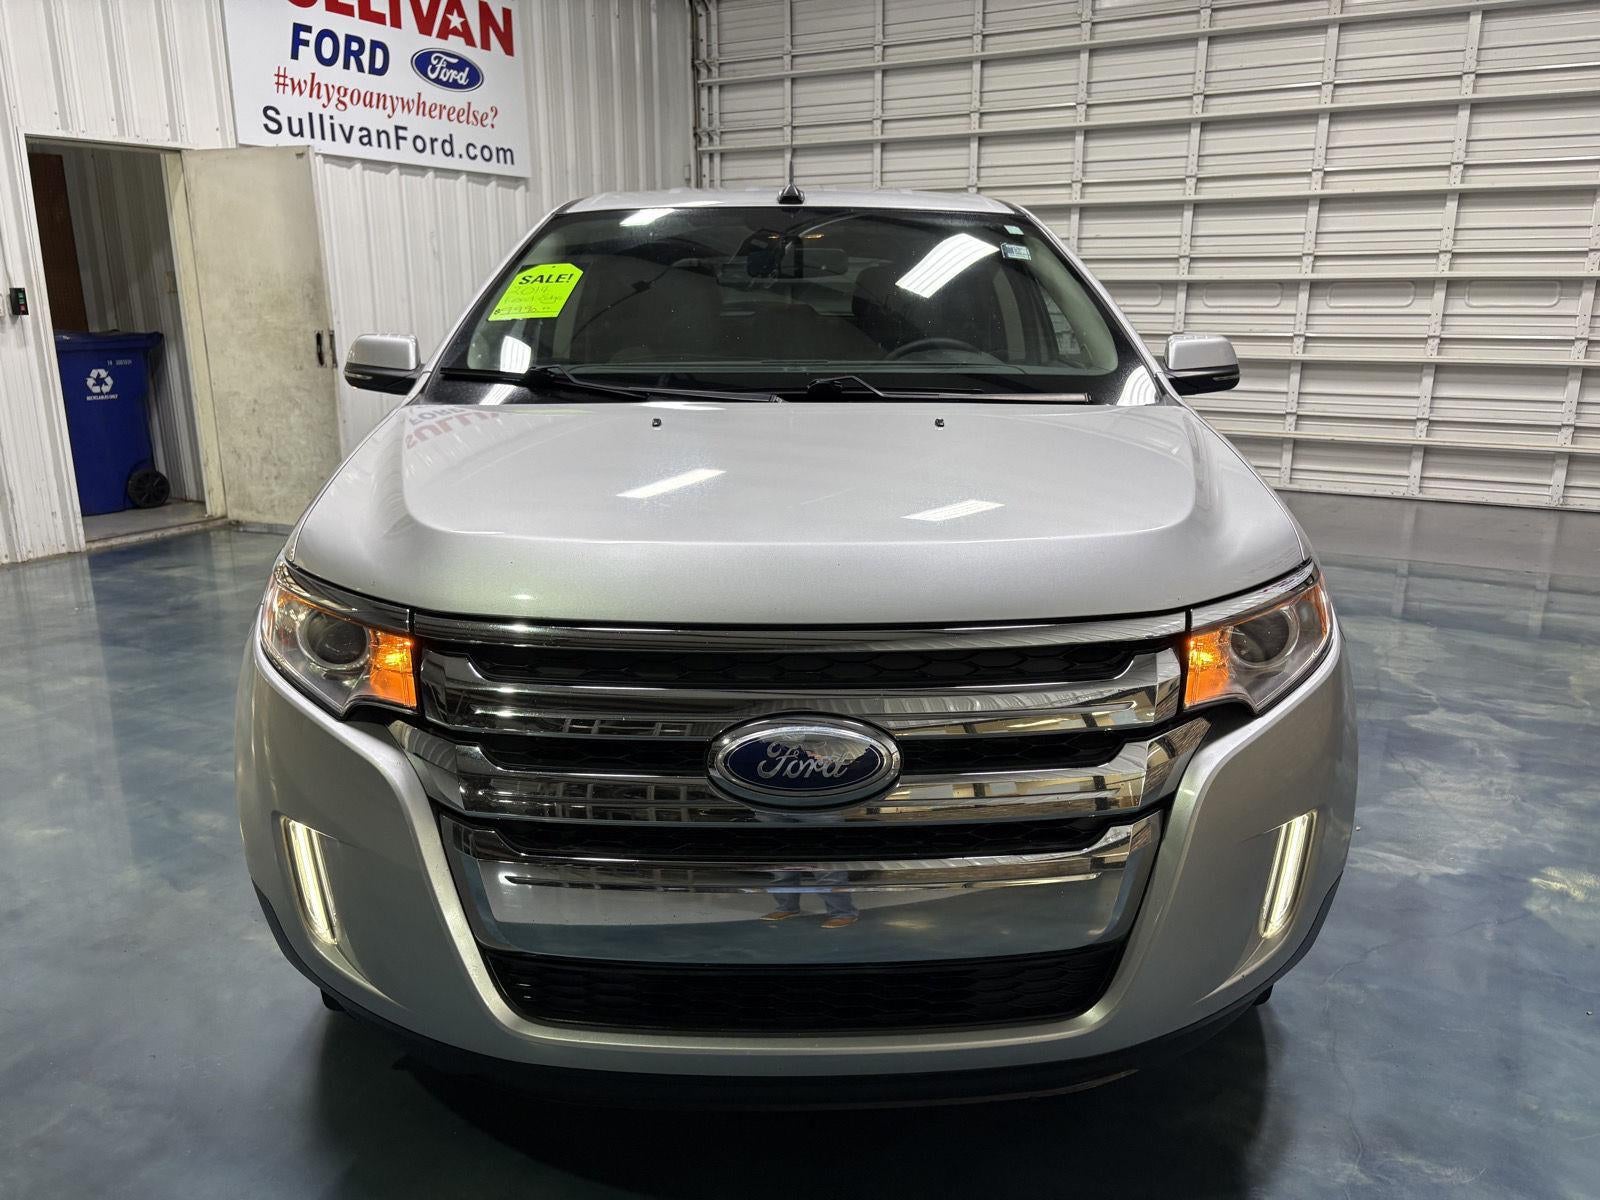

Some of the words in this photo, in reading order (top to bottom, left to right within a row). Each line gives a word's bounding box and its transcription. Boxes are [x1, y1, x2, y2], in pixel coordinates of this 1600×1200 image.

[290, 22, 390, 77] FORD
[427, 51, 470, 86] Ford
[274, 65, 498, 129] #whygoanywhereelse?
[262, 105, 515, 166] SullivanFord.com
[518, 273, 574, 285] SALE!
[757, 741, 851, 779] Ford
